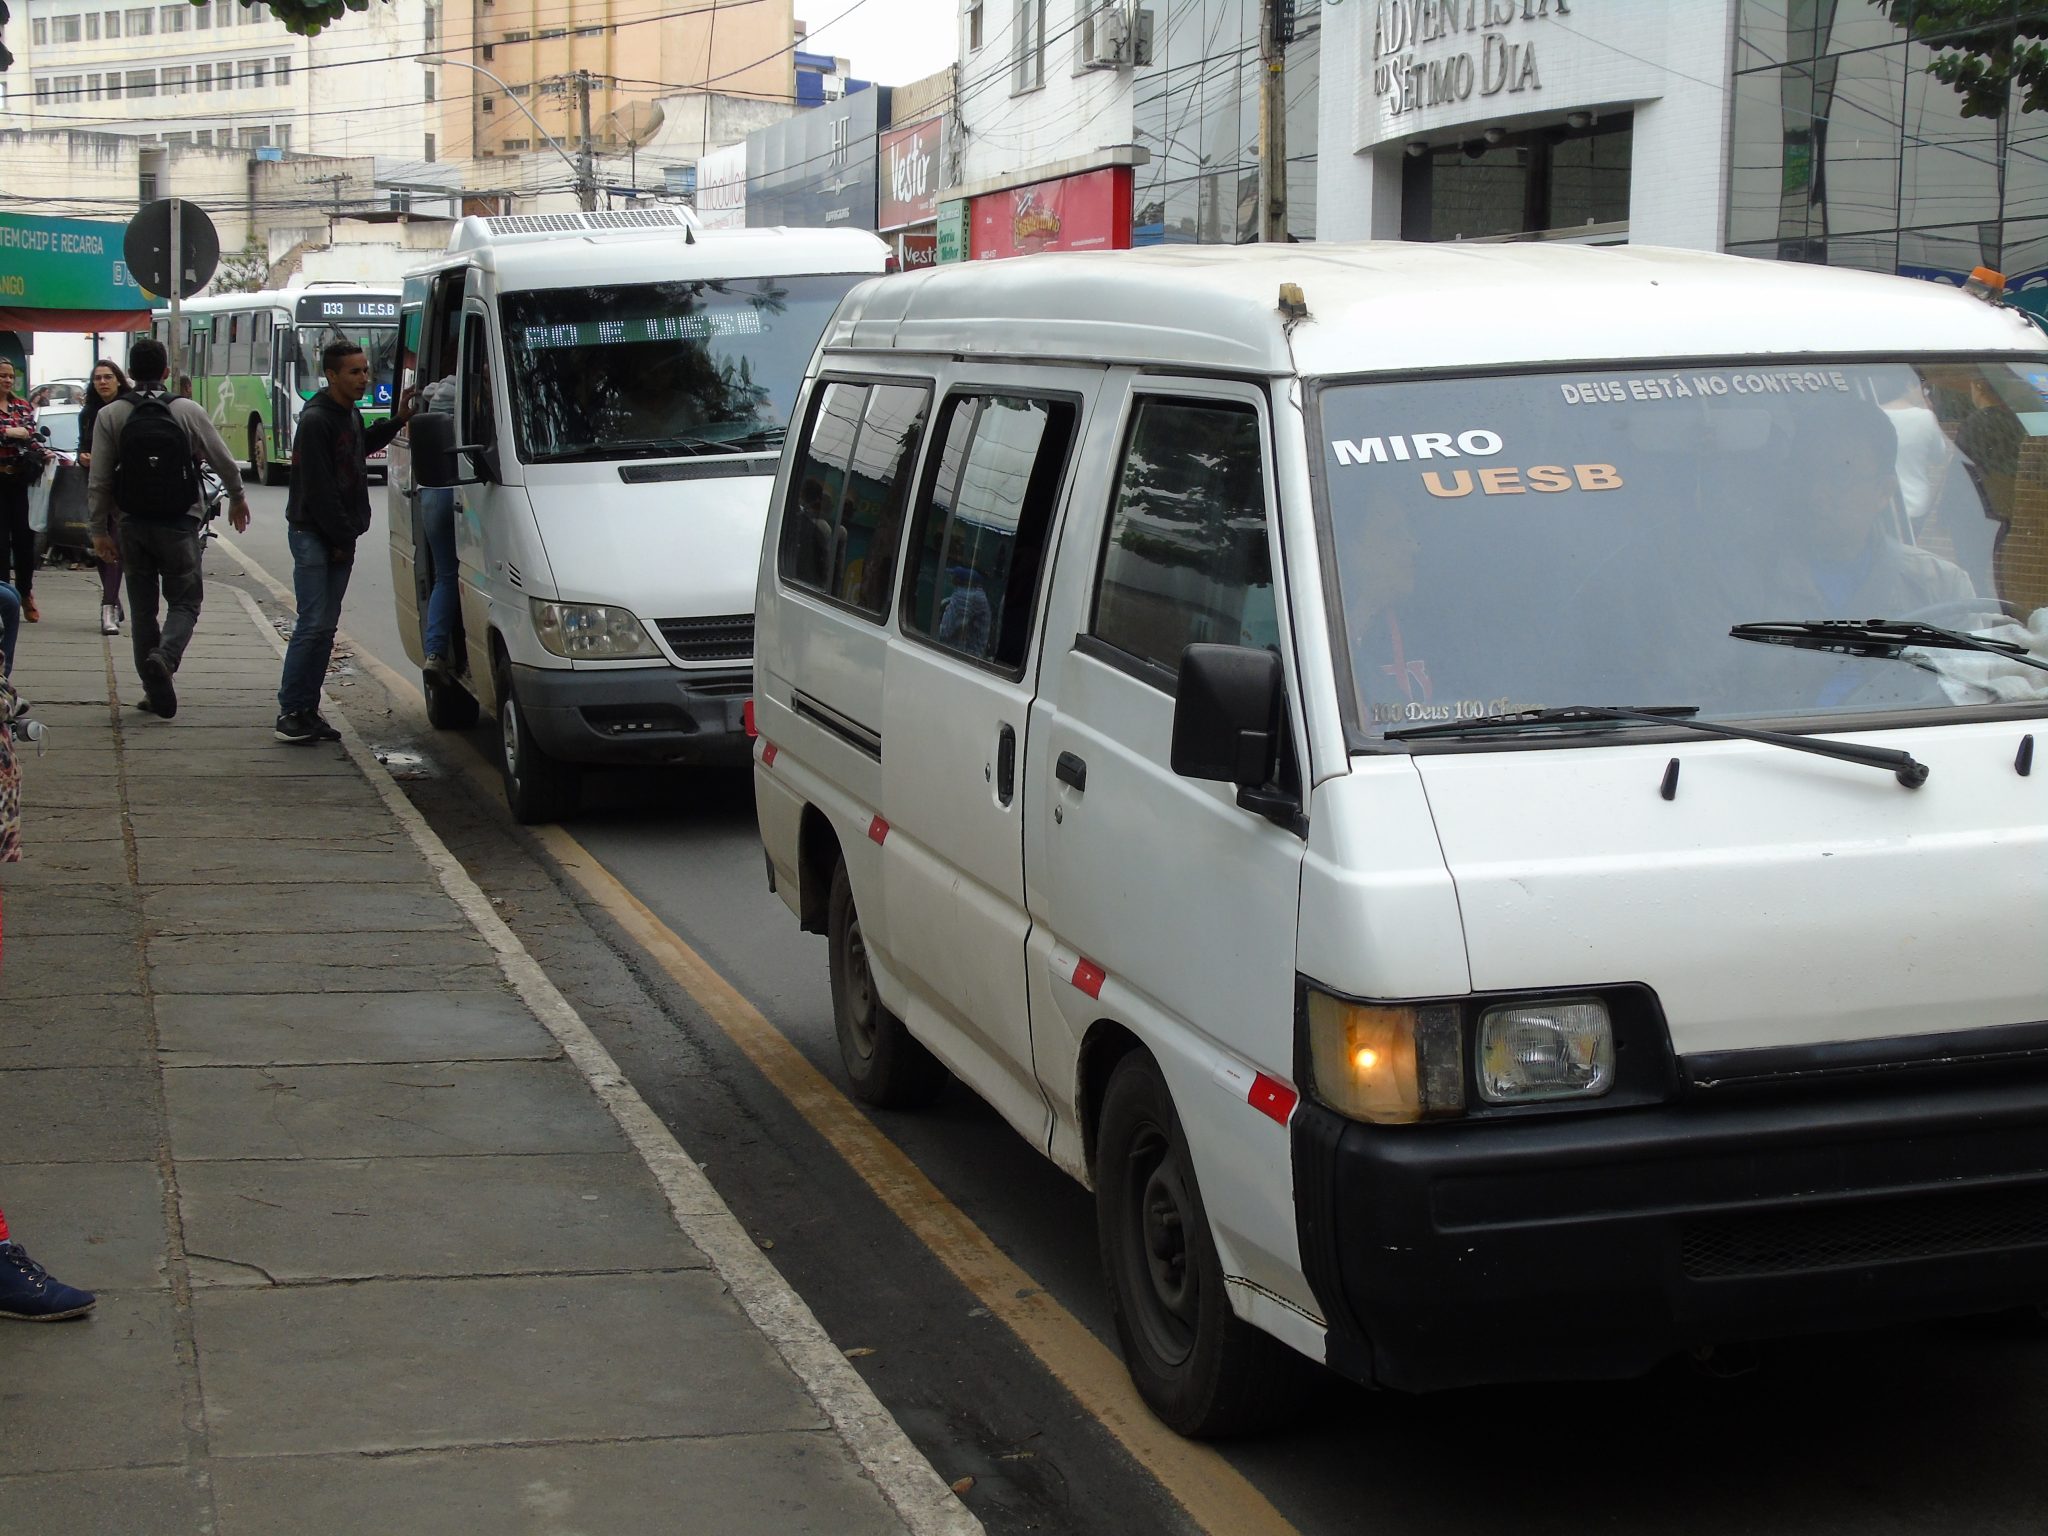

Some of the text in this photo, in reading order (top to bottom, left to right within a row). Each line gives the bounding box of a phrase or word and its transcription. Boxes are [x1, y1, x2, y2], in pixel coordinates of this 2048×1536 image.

[1372, 0, 1571, 61] ADVENTI
[1390, 53, 1475, 115] SÉTIMO
[1479, 33, 1543, 96] DIA
[22, 230, 49, 250] CHIP
[52, 233, 58, 252] E
[61, 233, 104, 254] RECARGA
[0, 275, 24, 296] NGO
[598, 320, 626, 343] E
[646, 311, 761, 341] UESB
[1560, 380, 1627, 405] DEUS
[1627, 374, 1693, 402] ESTÁ
[1693, 375, 1729, 397] NO
[1331, 429, 1504, 466] MIRO
[1421, 463, 1624, 498] UESB
[1405, 701, 1449, 721] Deus
[1454, 699, 1484, 719] 100
